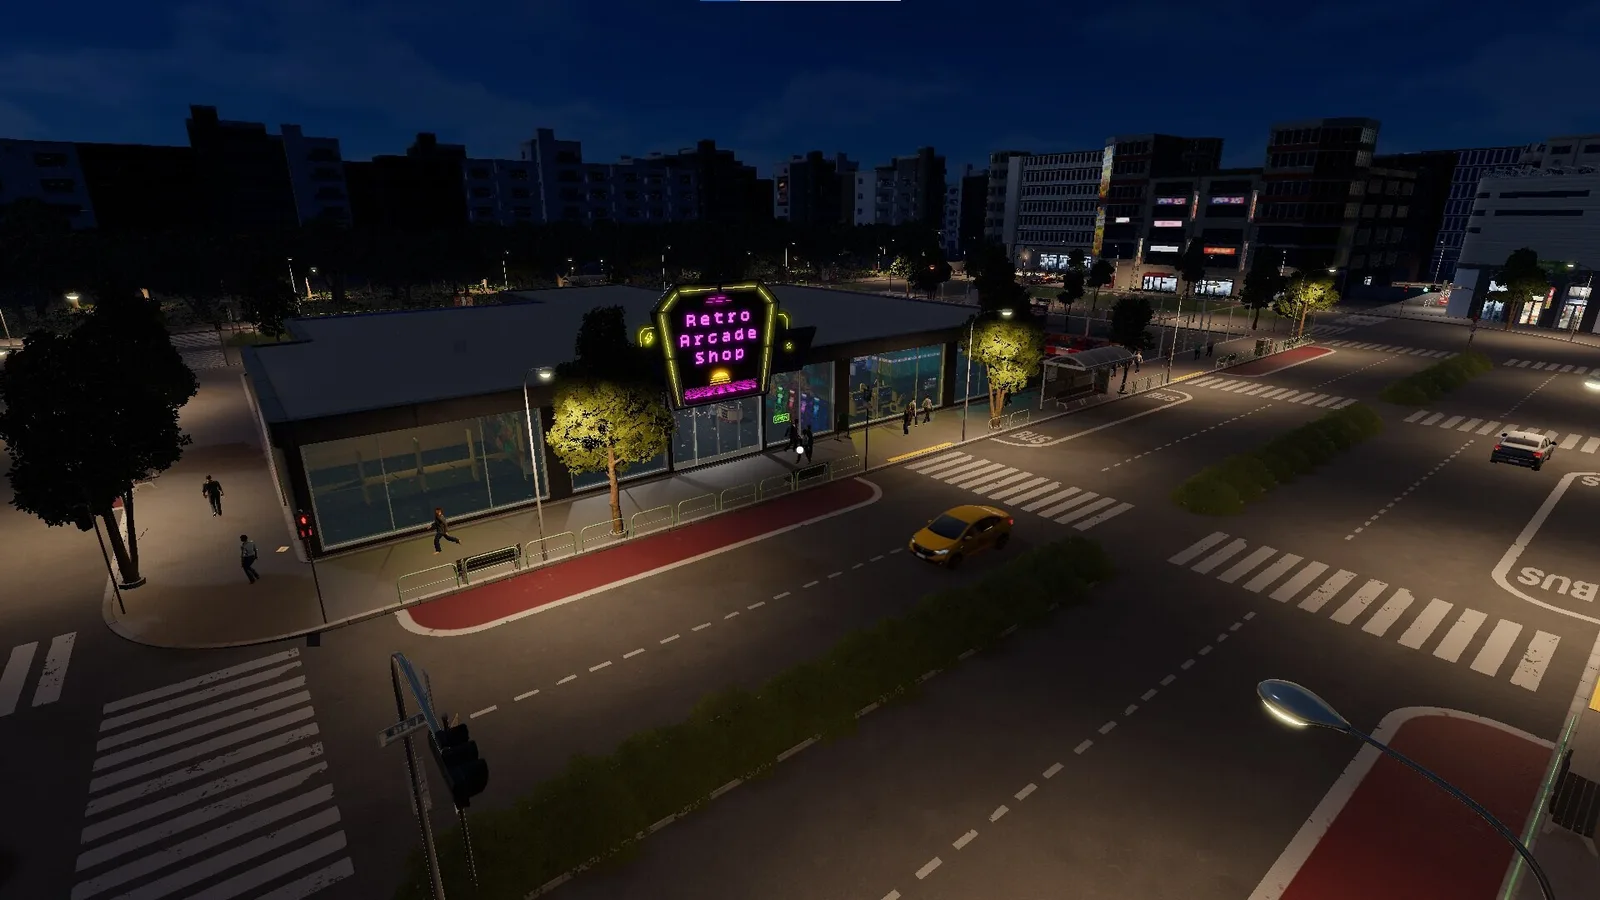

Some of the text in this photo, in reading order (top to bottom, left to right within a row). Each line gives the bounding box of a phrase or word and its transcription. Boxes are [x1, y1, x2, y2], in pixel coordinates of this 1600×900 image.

[685, 310, 751, 329] Retro
[678, 327, 758, 348] Arcade
[694, 348, 745, 365] Shop
[1145, 391, 1181, 403] BUS
[1009, 430, 1054, 444] BUS
[1516, 567, 1600, 602] BUS
